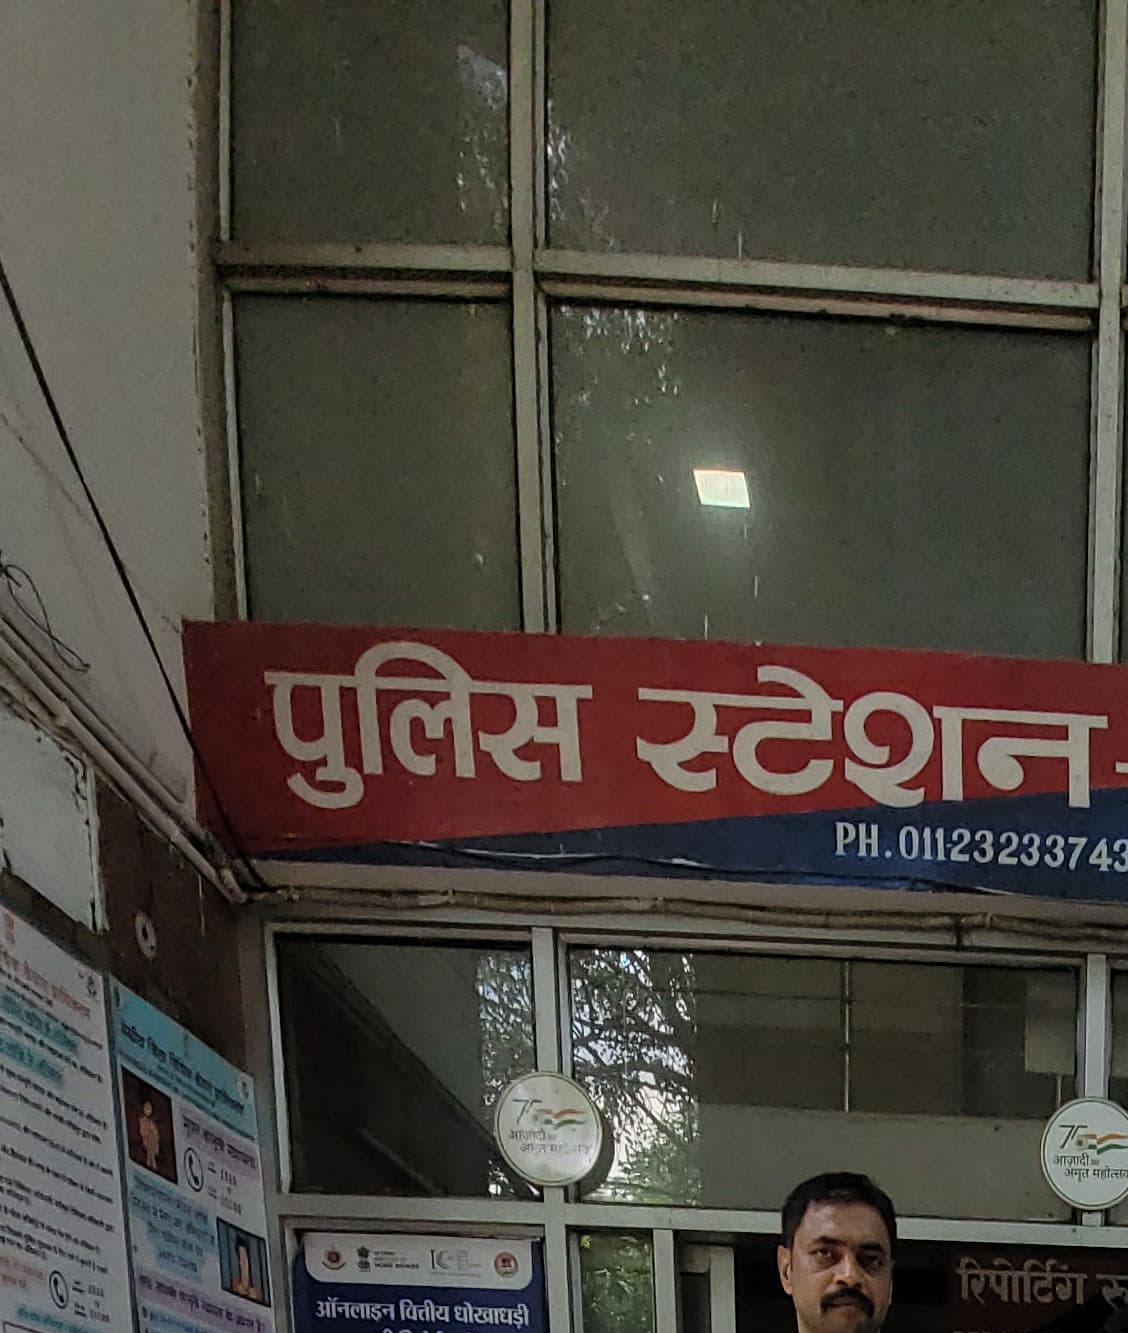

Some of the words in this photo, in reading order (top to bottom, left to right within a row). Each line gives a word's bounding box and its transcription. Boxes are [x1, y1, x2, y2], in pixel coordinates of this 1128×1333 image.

[264, 640, 593, 810] पुलिस
[637, 665, 1108, 810] स्टेशन
[956, 1256, 1089, 1306] रिपोर्टिंग
[314, 1297, 396, 1321] ऑनलाइन
[400, 1299, 450, 1323] वित्तीय
[454, 1302, 529, 1329] धोखाधड़ी
